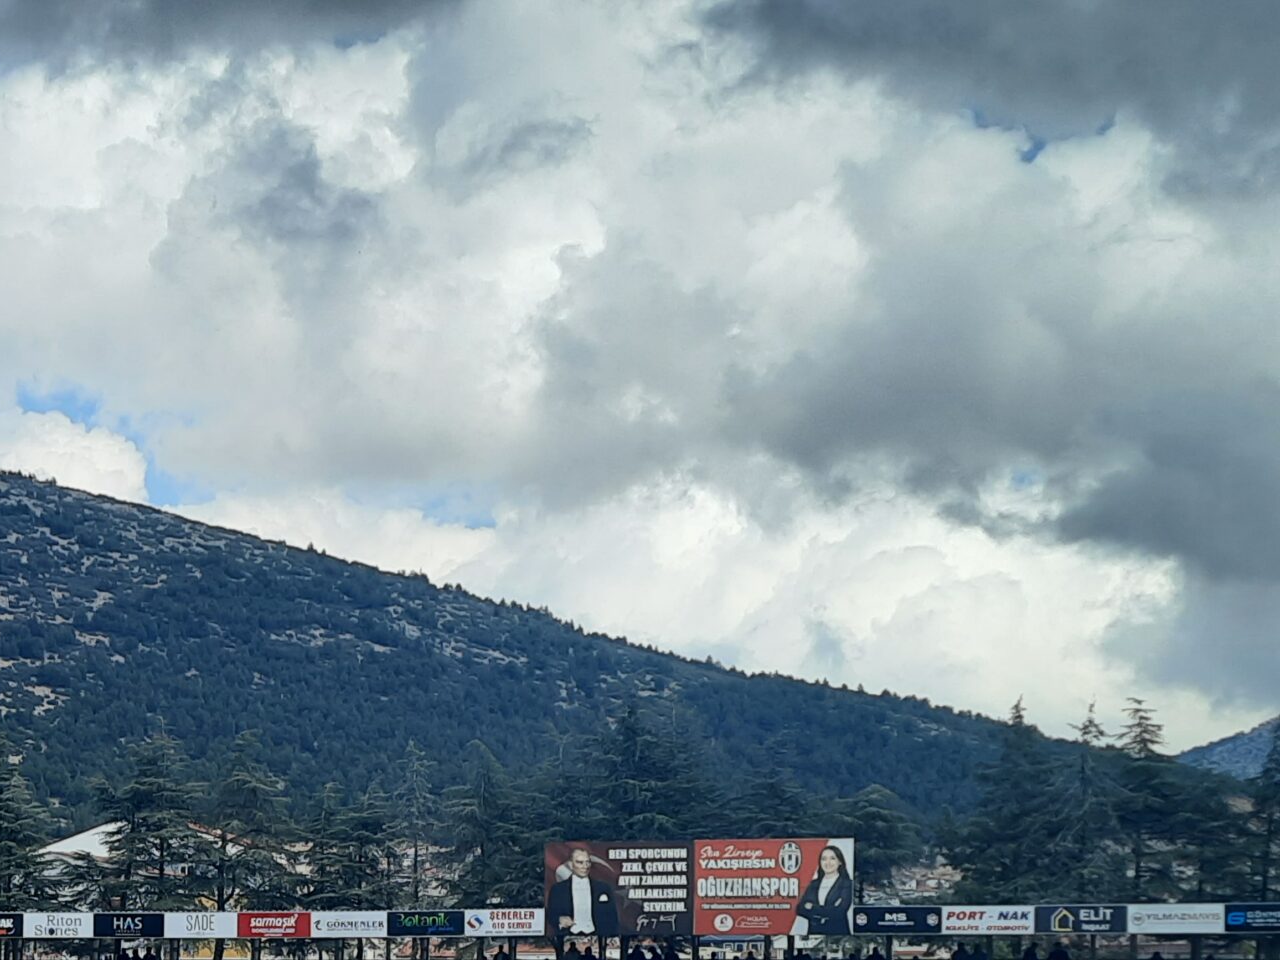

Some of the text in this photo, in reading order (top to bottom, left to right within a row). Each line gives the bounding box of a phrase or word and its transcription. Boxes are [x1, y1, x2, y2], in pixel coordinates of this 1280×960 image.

[608, 848, 687, 859] BEN SPORCUNUN
[674, 861, 688, 872] VE
[641, 875, 688, 885] ZAMANDA
[697, 876, 799, 897] OĞUZHANSPOR
[47, 915, 82, 926] Riton
[946, 911, 987, 920] PORT
[997, 911, 1031, 920] NAK
[113, 916, 143, 930] HAS
[185, 914, 215, 931] SADE
